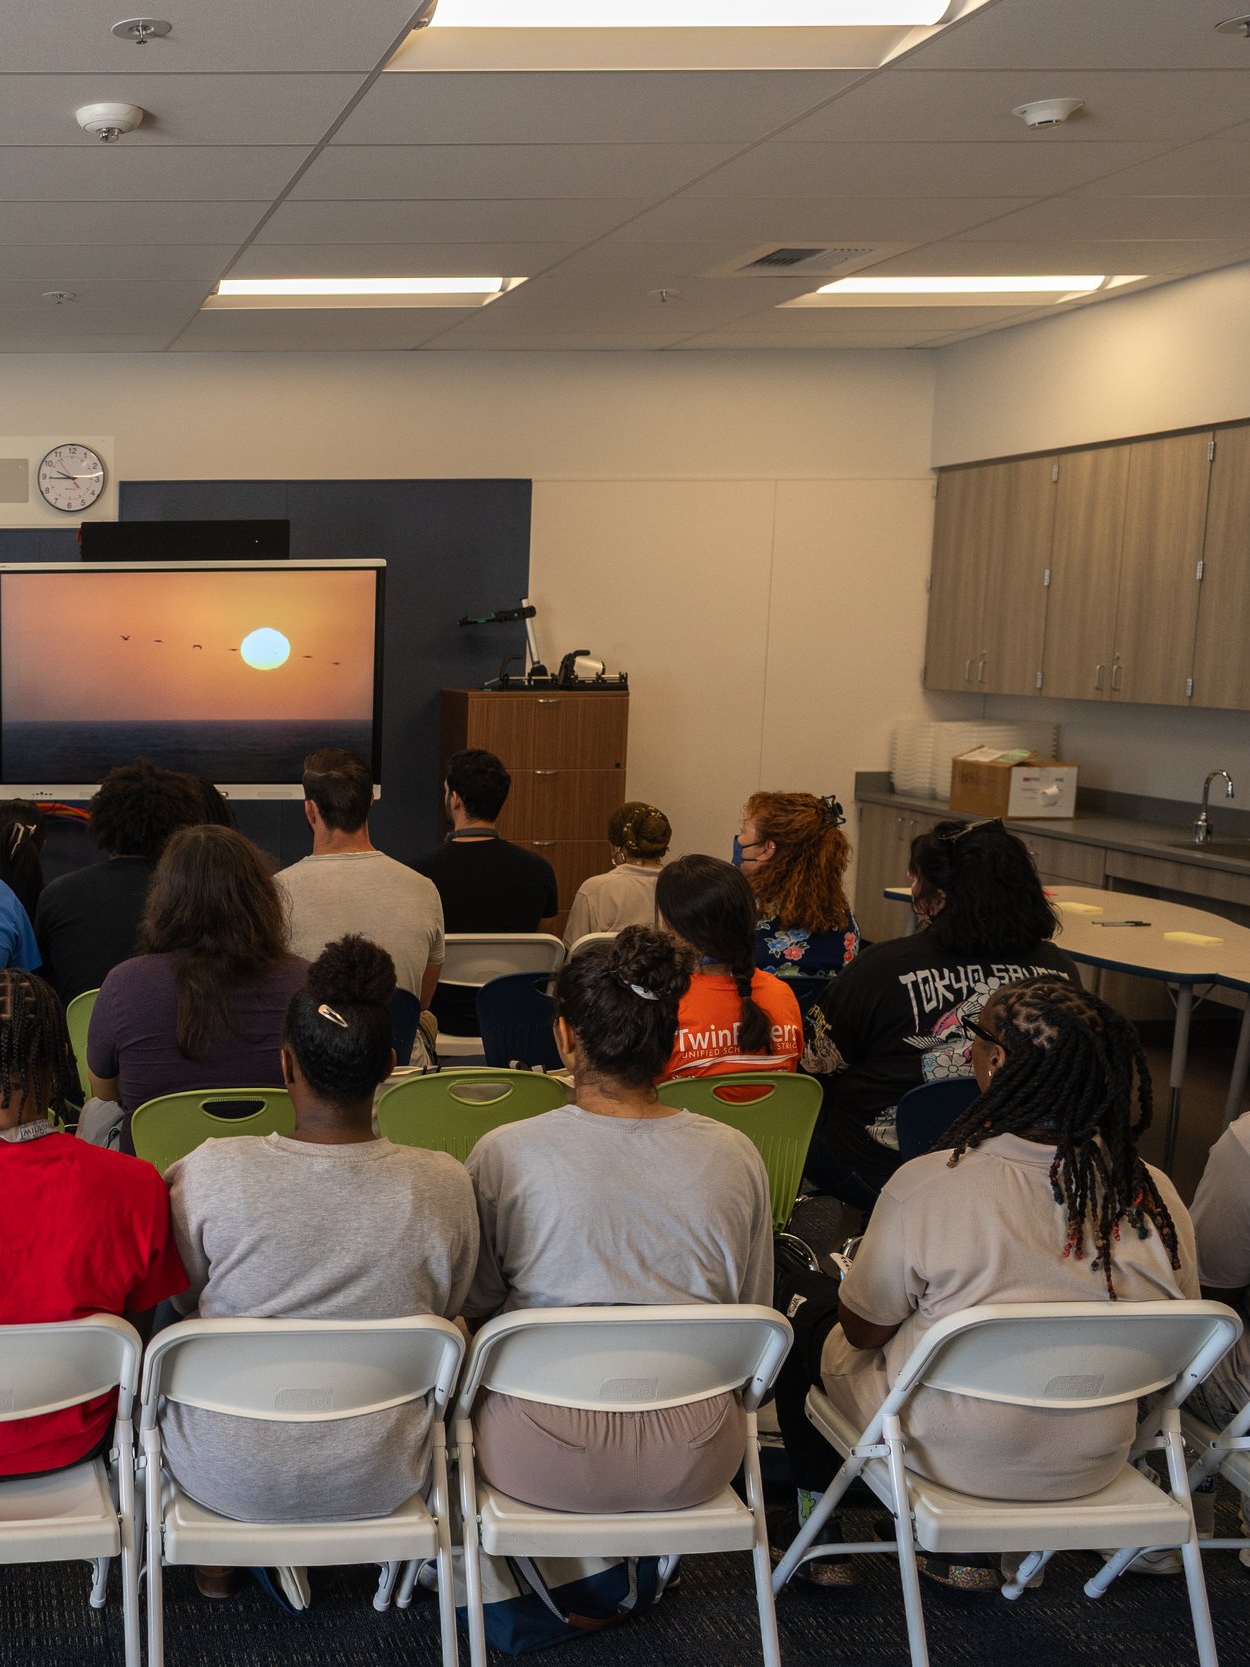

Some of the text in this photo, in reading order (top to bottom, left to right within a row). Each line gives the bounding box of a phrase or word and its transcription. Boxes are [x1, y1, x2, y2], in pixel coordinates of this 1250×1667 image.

[81, 498, 86, 506] 5
[899, 965, 985, 1033] TOKYO
[681, 1048, 720, 1059] UNIFIED
